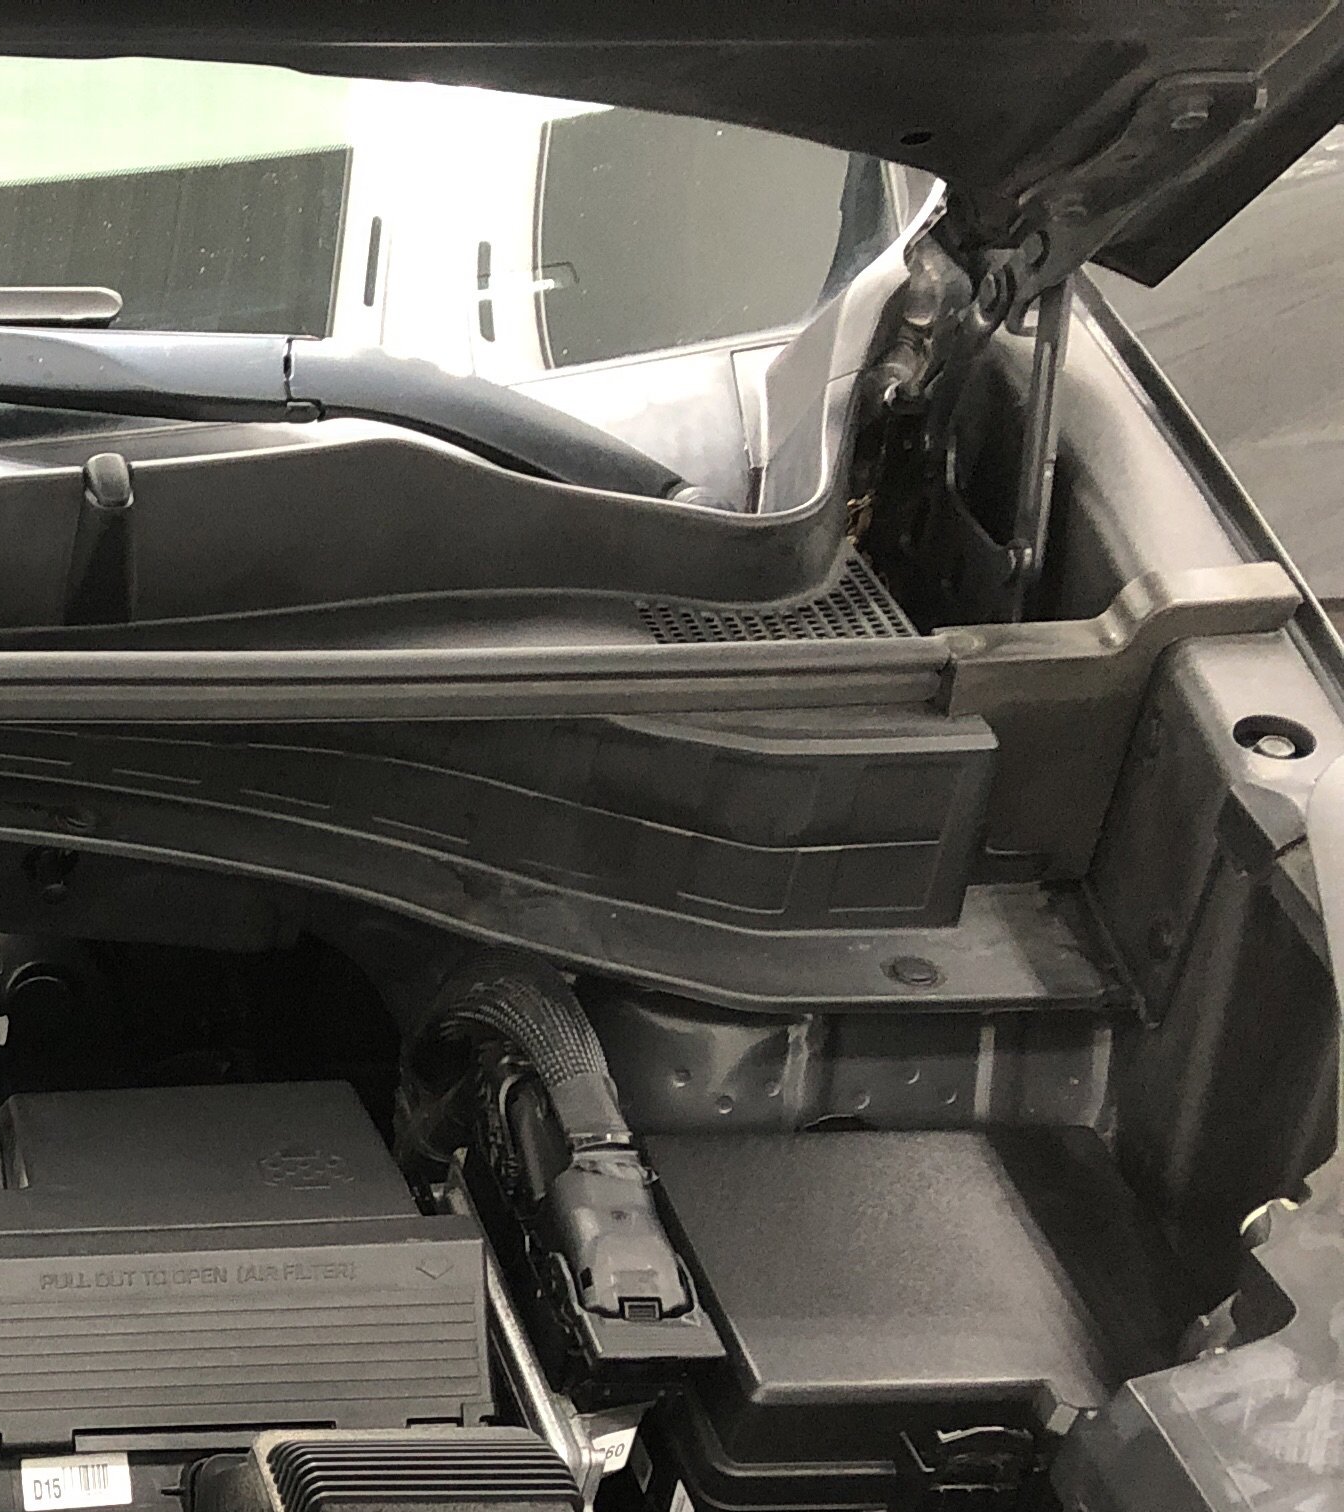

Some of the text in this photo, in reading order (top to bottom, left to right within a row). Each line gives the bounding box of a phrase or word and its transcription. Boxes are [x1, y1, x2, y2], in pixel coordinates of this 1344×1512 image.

[40, 1270, 92, 1291] PULL
[95, 1269, 134, 1288] OUT
[141, 1268, 168, 1287] TO
[172, 1264, 228, 1286] OPEN
[33, 1478, 62, 1501] D15
